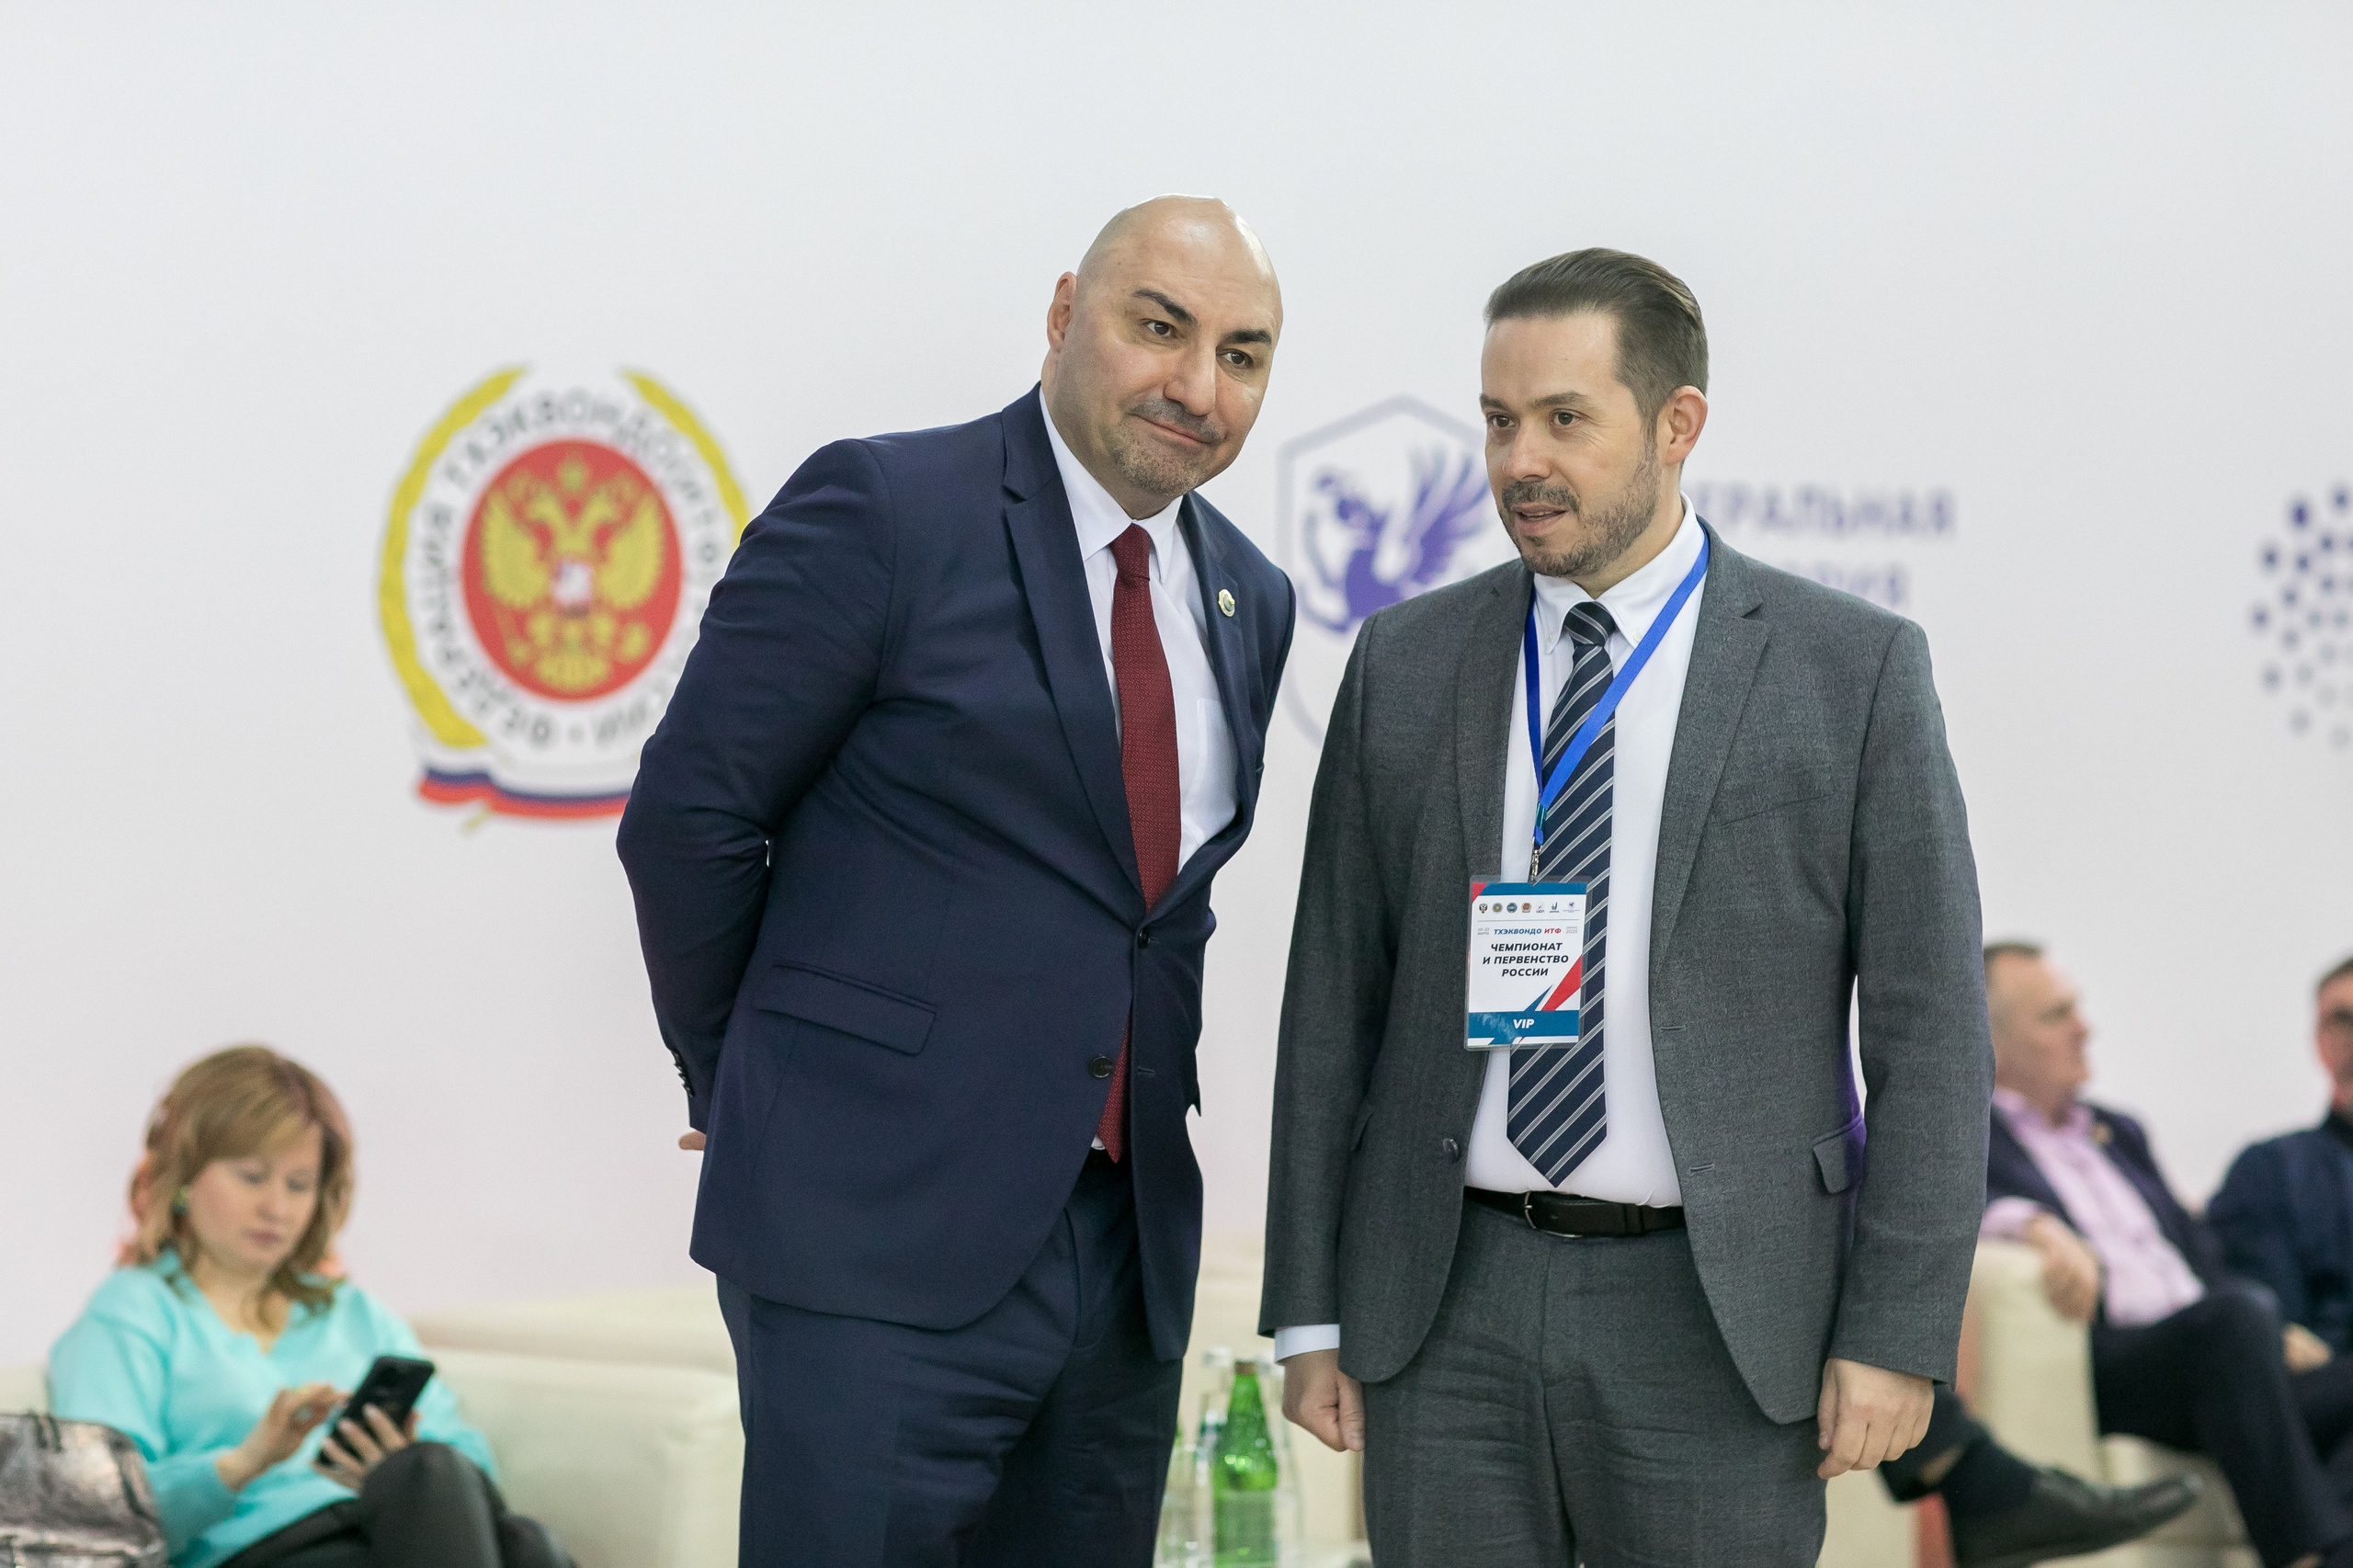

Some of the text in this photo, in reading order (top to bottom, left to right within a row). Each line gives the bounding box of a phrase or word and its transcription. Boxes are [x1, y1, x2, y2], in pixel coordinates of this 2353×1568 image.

[1689, 480, 1955, 537] ЕРАЛЬНАЯ
[1494, 927, 1542, 936] ТХЭКВОНДО
[1491, 942, 1563, 952] ЧЕМПИОНАТ
[1483, 955, 1569, 965] И ПЕРВЕНСТВО
[1501, 968, 1549, 977] РОССИИ
[1513, 1018, 1535, 1029] VIP
